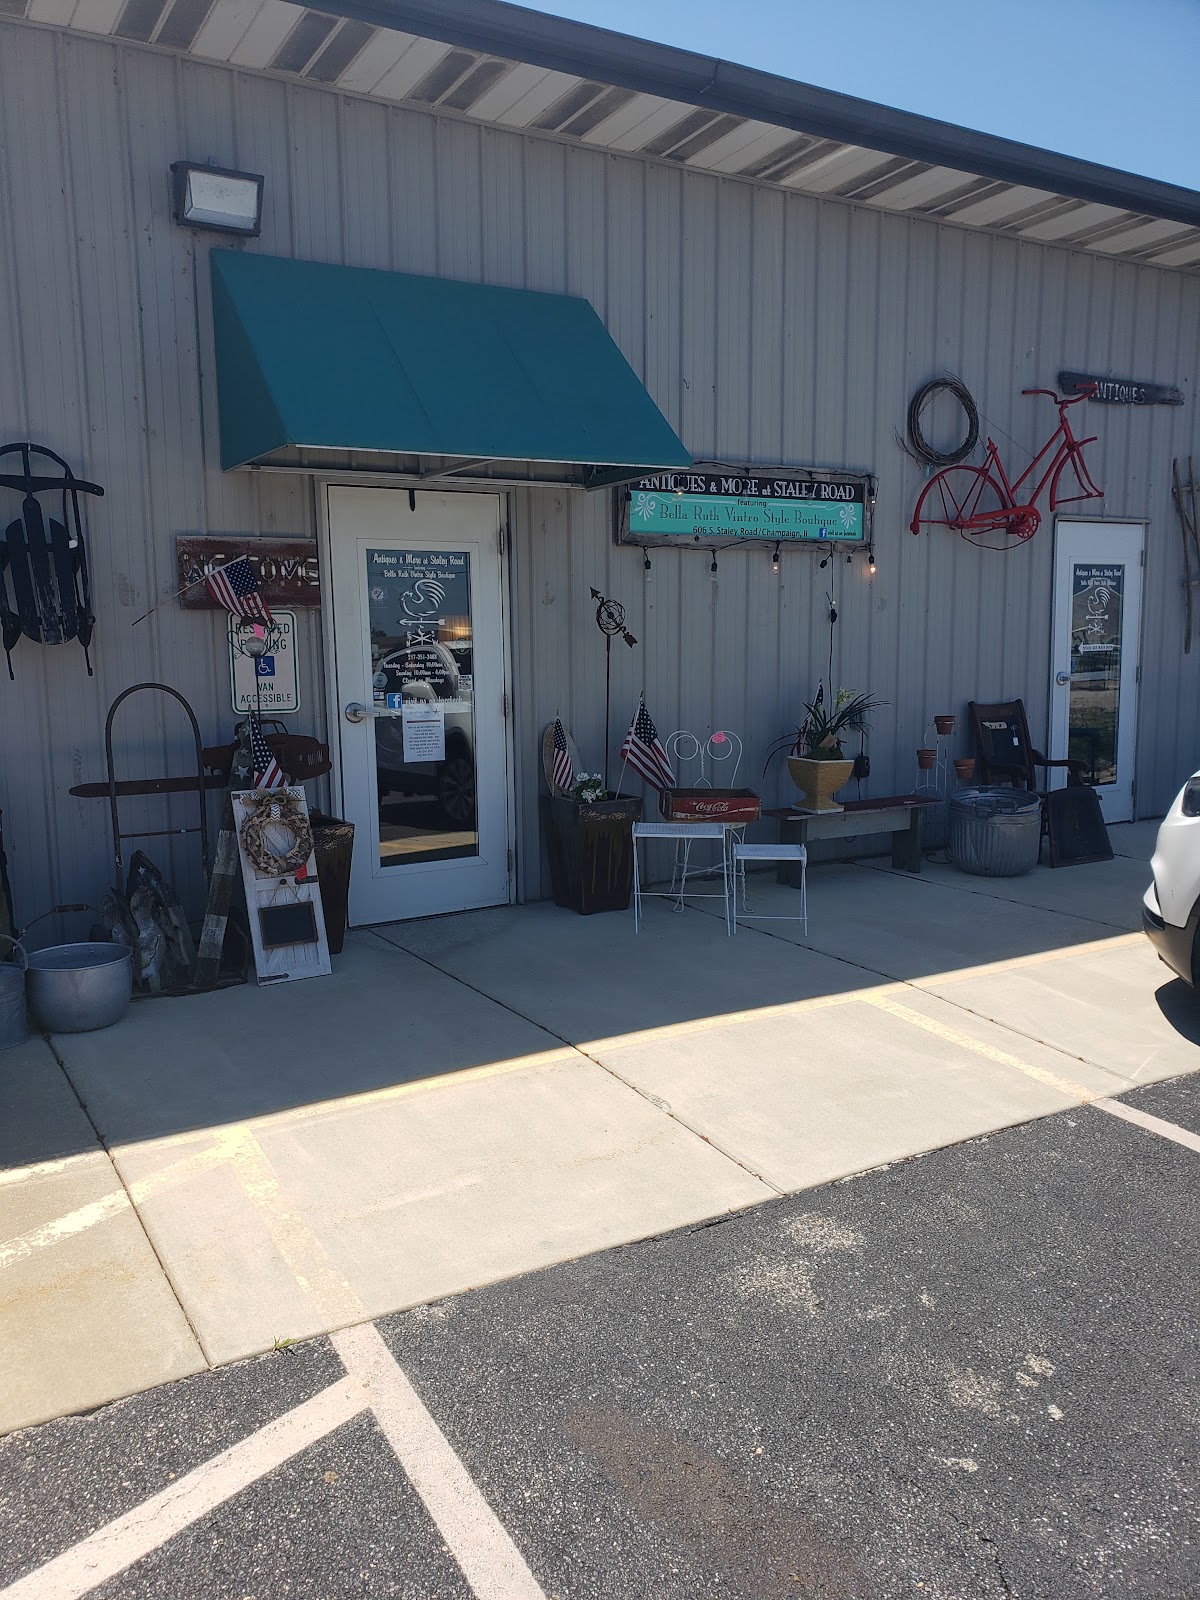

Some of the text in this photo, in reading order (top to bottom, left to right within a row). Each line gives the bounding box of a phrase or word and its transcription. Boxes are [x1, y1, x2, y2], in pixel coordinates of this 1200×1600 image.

[710, 482, 717, 493] &
[762, 485, 771, 495] at
[821, 484, 855, 500] ROAD
[737, 498, 767, 508] featuring
[660, 504, 838, 527] Bella Ruth Vintro Style Boutique
[692, 526, 707, 535] 606
[709, 527, 715, 535] S.
[717, 527, 738, 536] Staley
[373, 553, 398, 566] Antiques
[405, 554, 422, 565] More
[430, 555, 448, 567] Staley
[449, 556, 464, 565] Road
[257, 682, 274, 692] VAN
[240, 693, 293, 704] ACCESSIBLE
